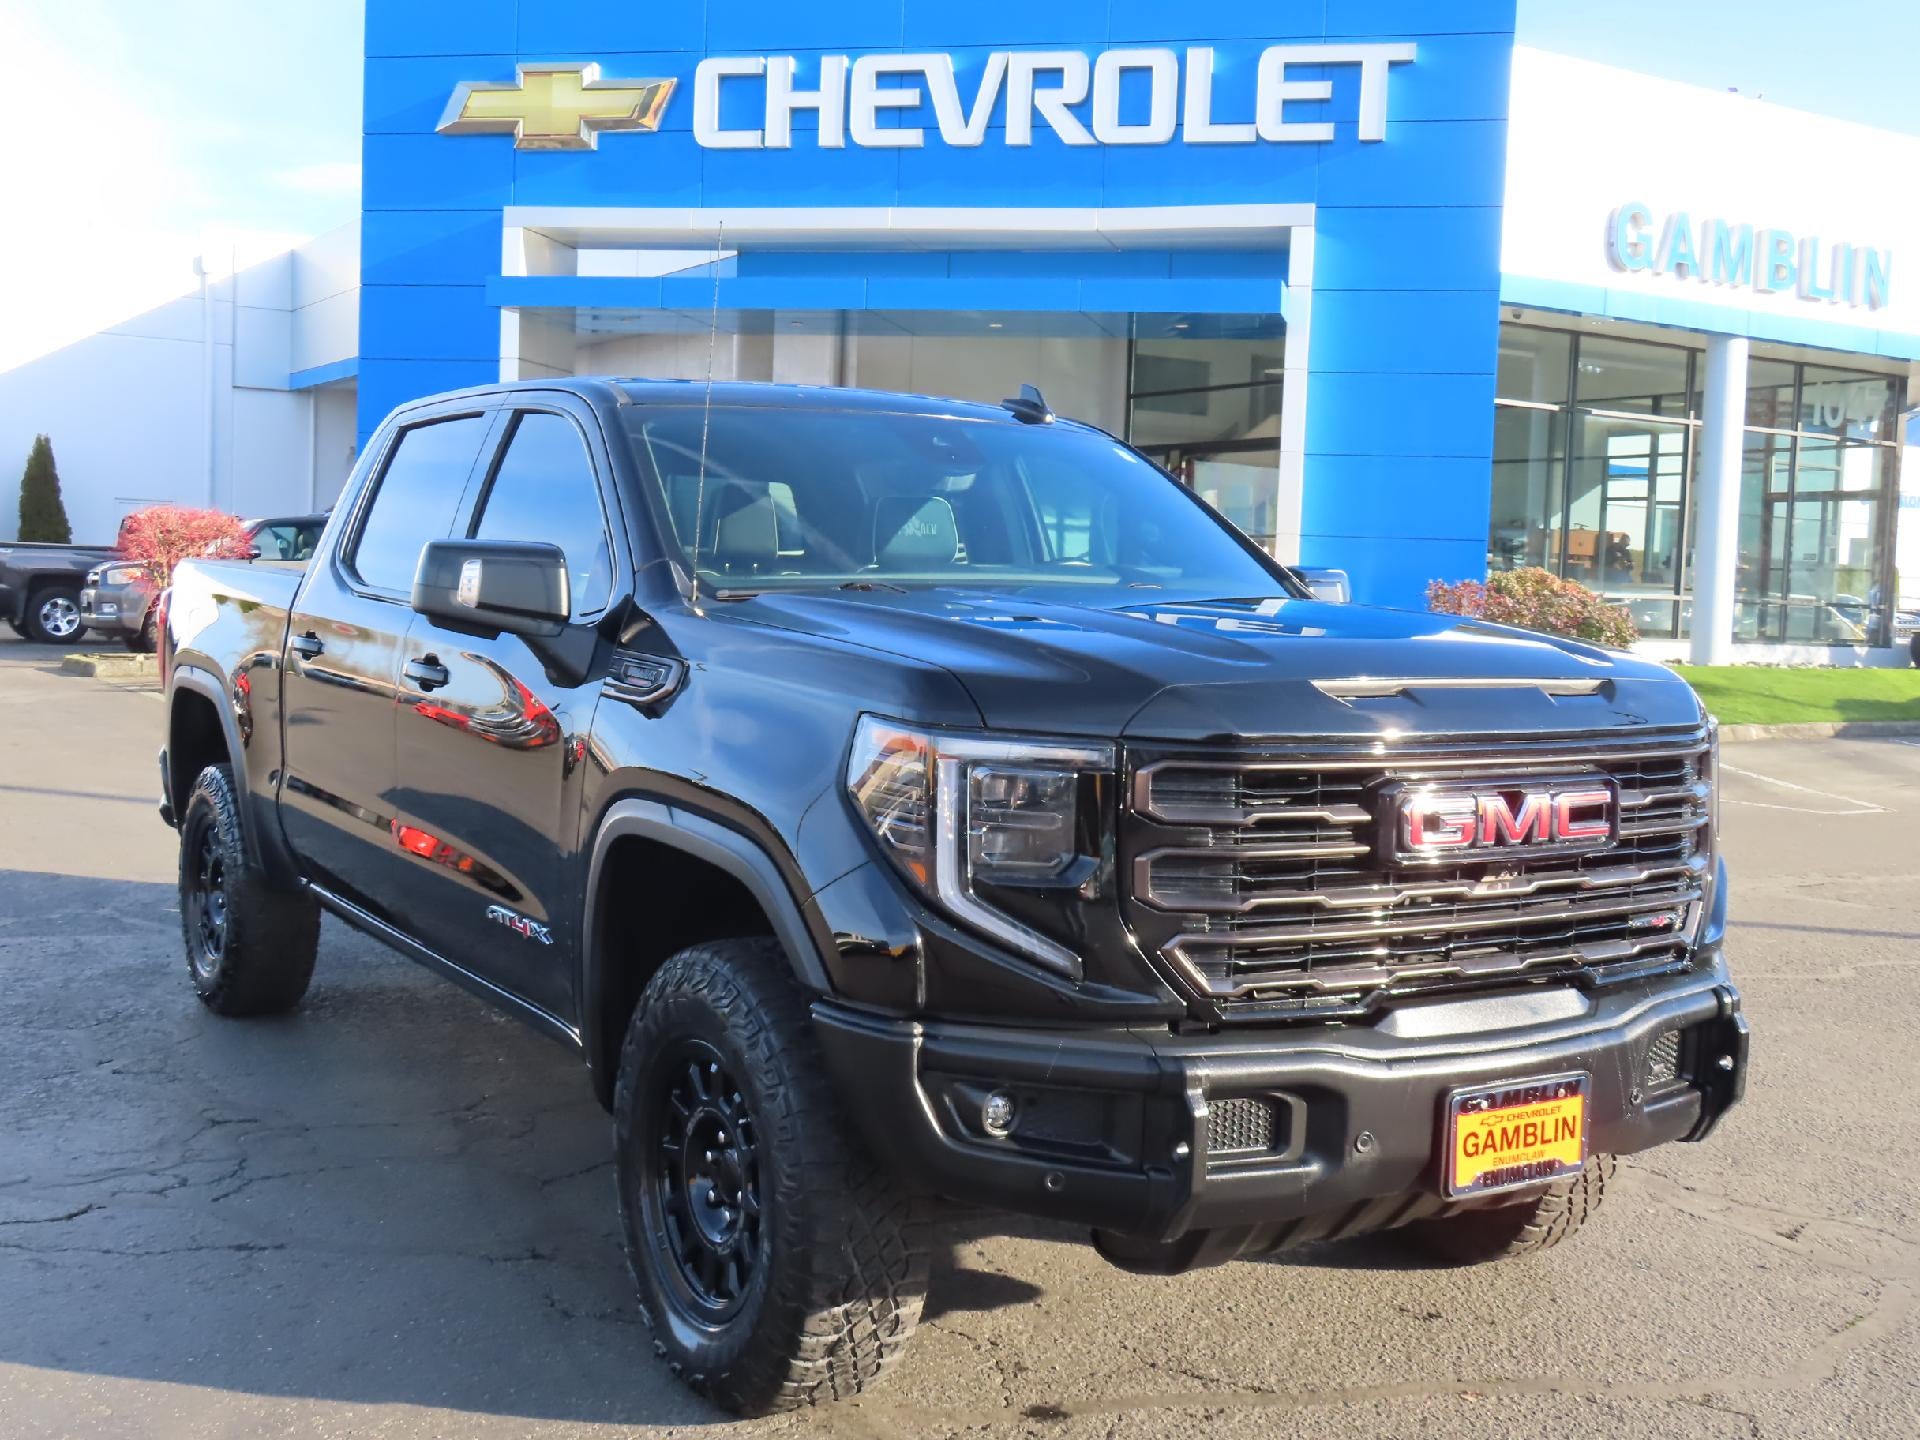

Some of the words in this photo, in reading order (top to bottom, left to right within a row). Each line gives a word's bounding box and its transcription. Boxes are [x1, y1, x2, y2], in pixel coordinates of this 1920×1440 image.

[693, 43, 1417, 150] CHEVROLET
[1607, 202, 1892, 309] GAMBLIN
[1403, 789, 1612, 851] GMC
[1463, 1115, 1576, 1158] GAMBLIN
[1506, 1105, 1562, 1122] CHEVROLET
[1492, 1149, 1547, 1167] ENUMCLAW
